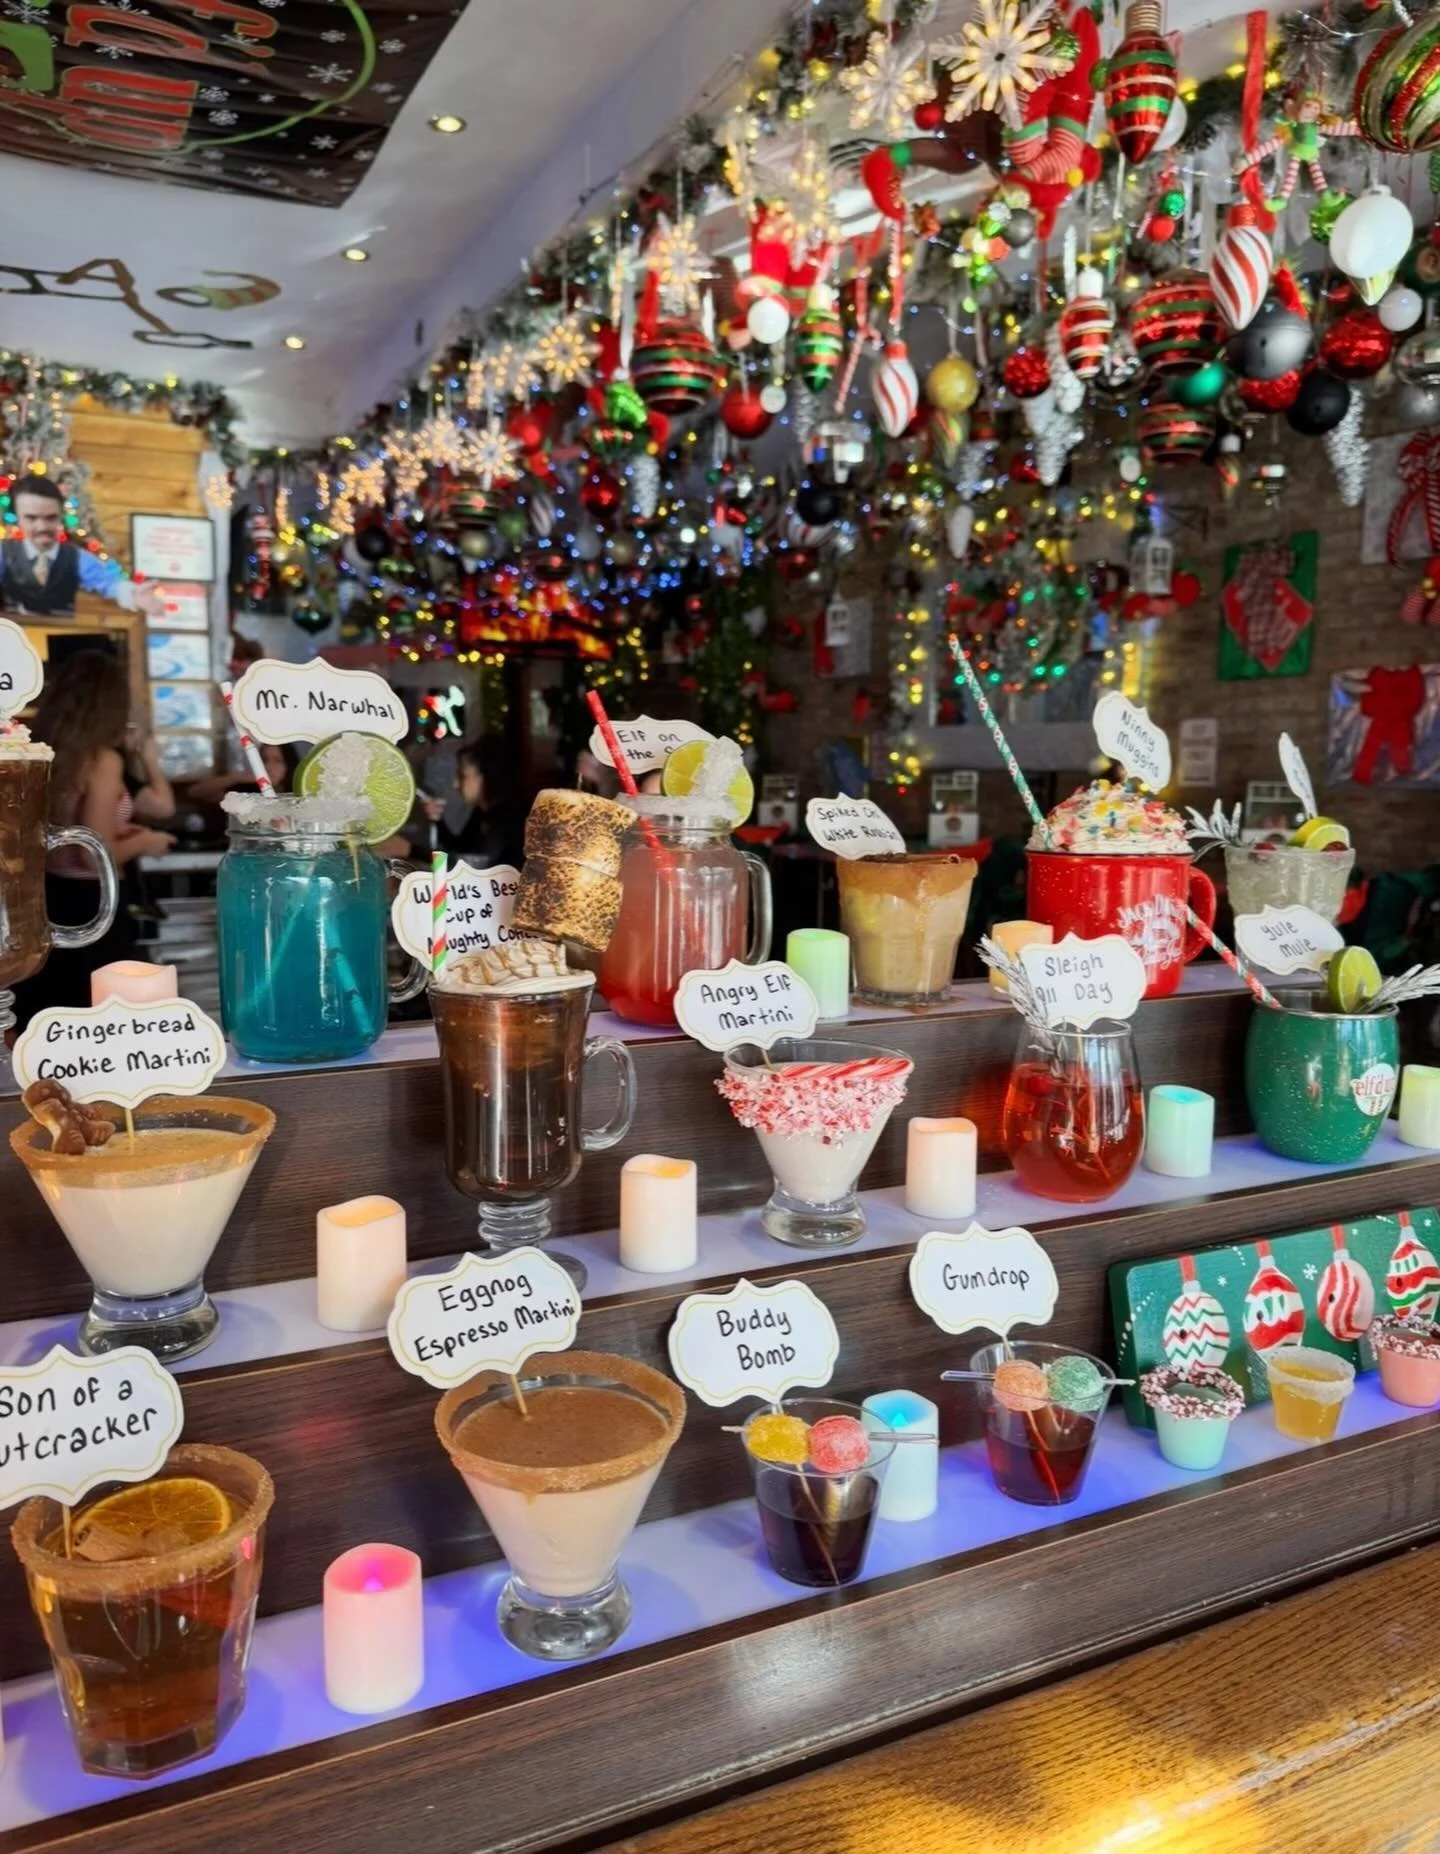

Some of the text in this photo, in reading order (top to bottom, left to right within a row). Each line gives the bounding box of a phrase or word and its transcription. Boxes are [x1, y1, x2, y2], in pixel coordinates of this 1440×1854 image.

[256, 689, 396, 721] Mr. Narwhal
[617, 729, 682, 743] Elf on
[626, 748, 655, 760] the
[817, 806, 860, 822] Spiked
[823, 828, 858, 842] White
[413, 884, 481, 904] Wld's
[480, 903, 494, 918] of
[427, 931, 490, 955] ughty
[1044, 953, 1104, 979] Sleigh
[700, 974, 792, 1006] Angry Elf
[1074, 981, 1113, 1004] Day
[46, 1013, 196, 1045] Gingerbread
[718, 1005, 795, 1031] Martini
[37, 1047, 212, 1080] Cookie Martini
[943, 1263, 1030, 1291] Gumdrop
[438, 1274, 533, 1312] Eggnog
[414, 1298, 576, 1362] Espresso Martini
[716, 1308, 792, 1336] Buddy
[737, 1344, 796, 1371] Bomb
[0, 1377, 134, 1418] Son of a
